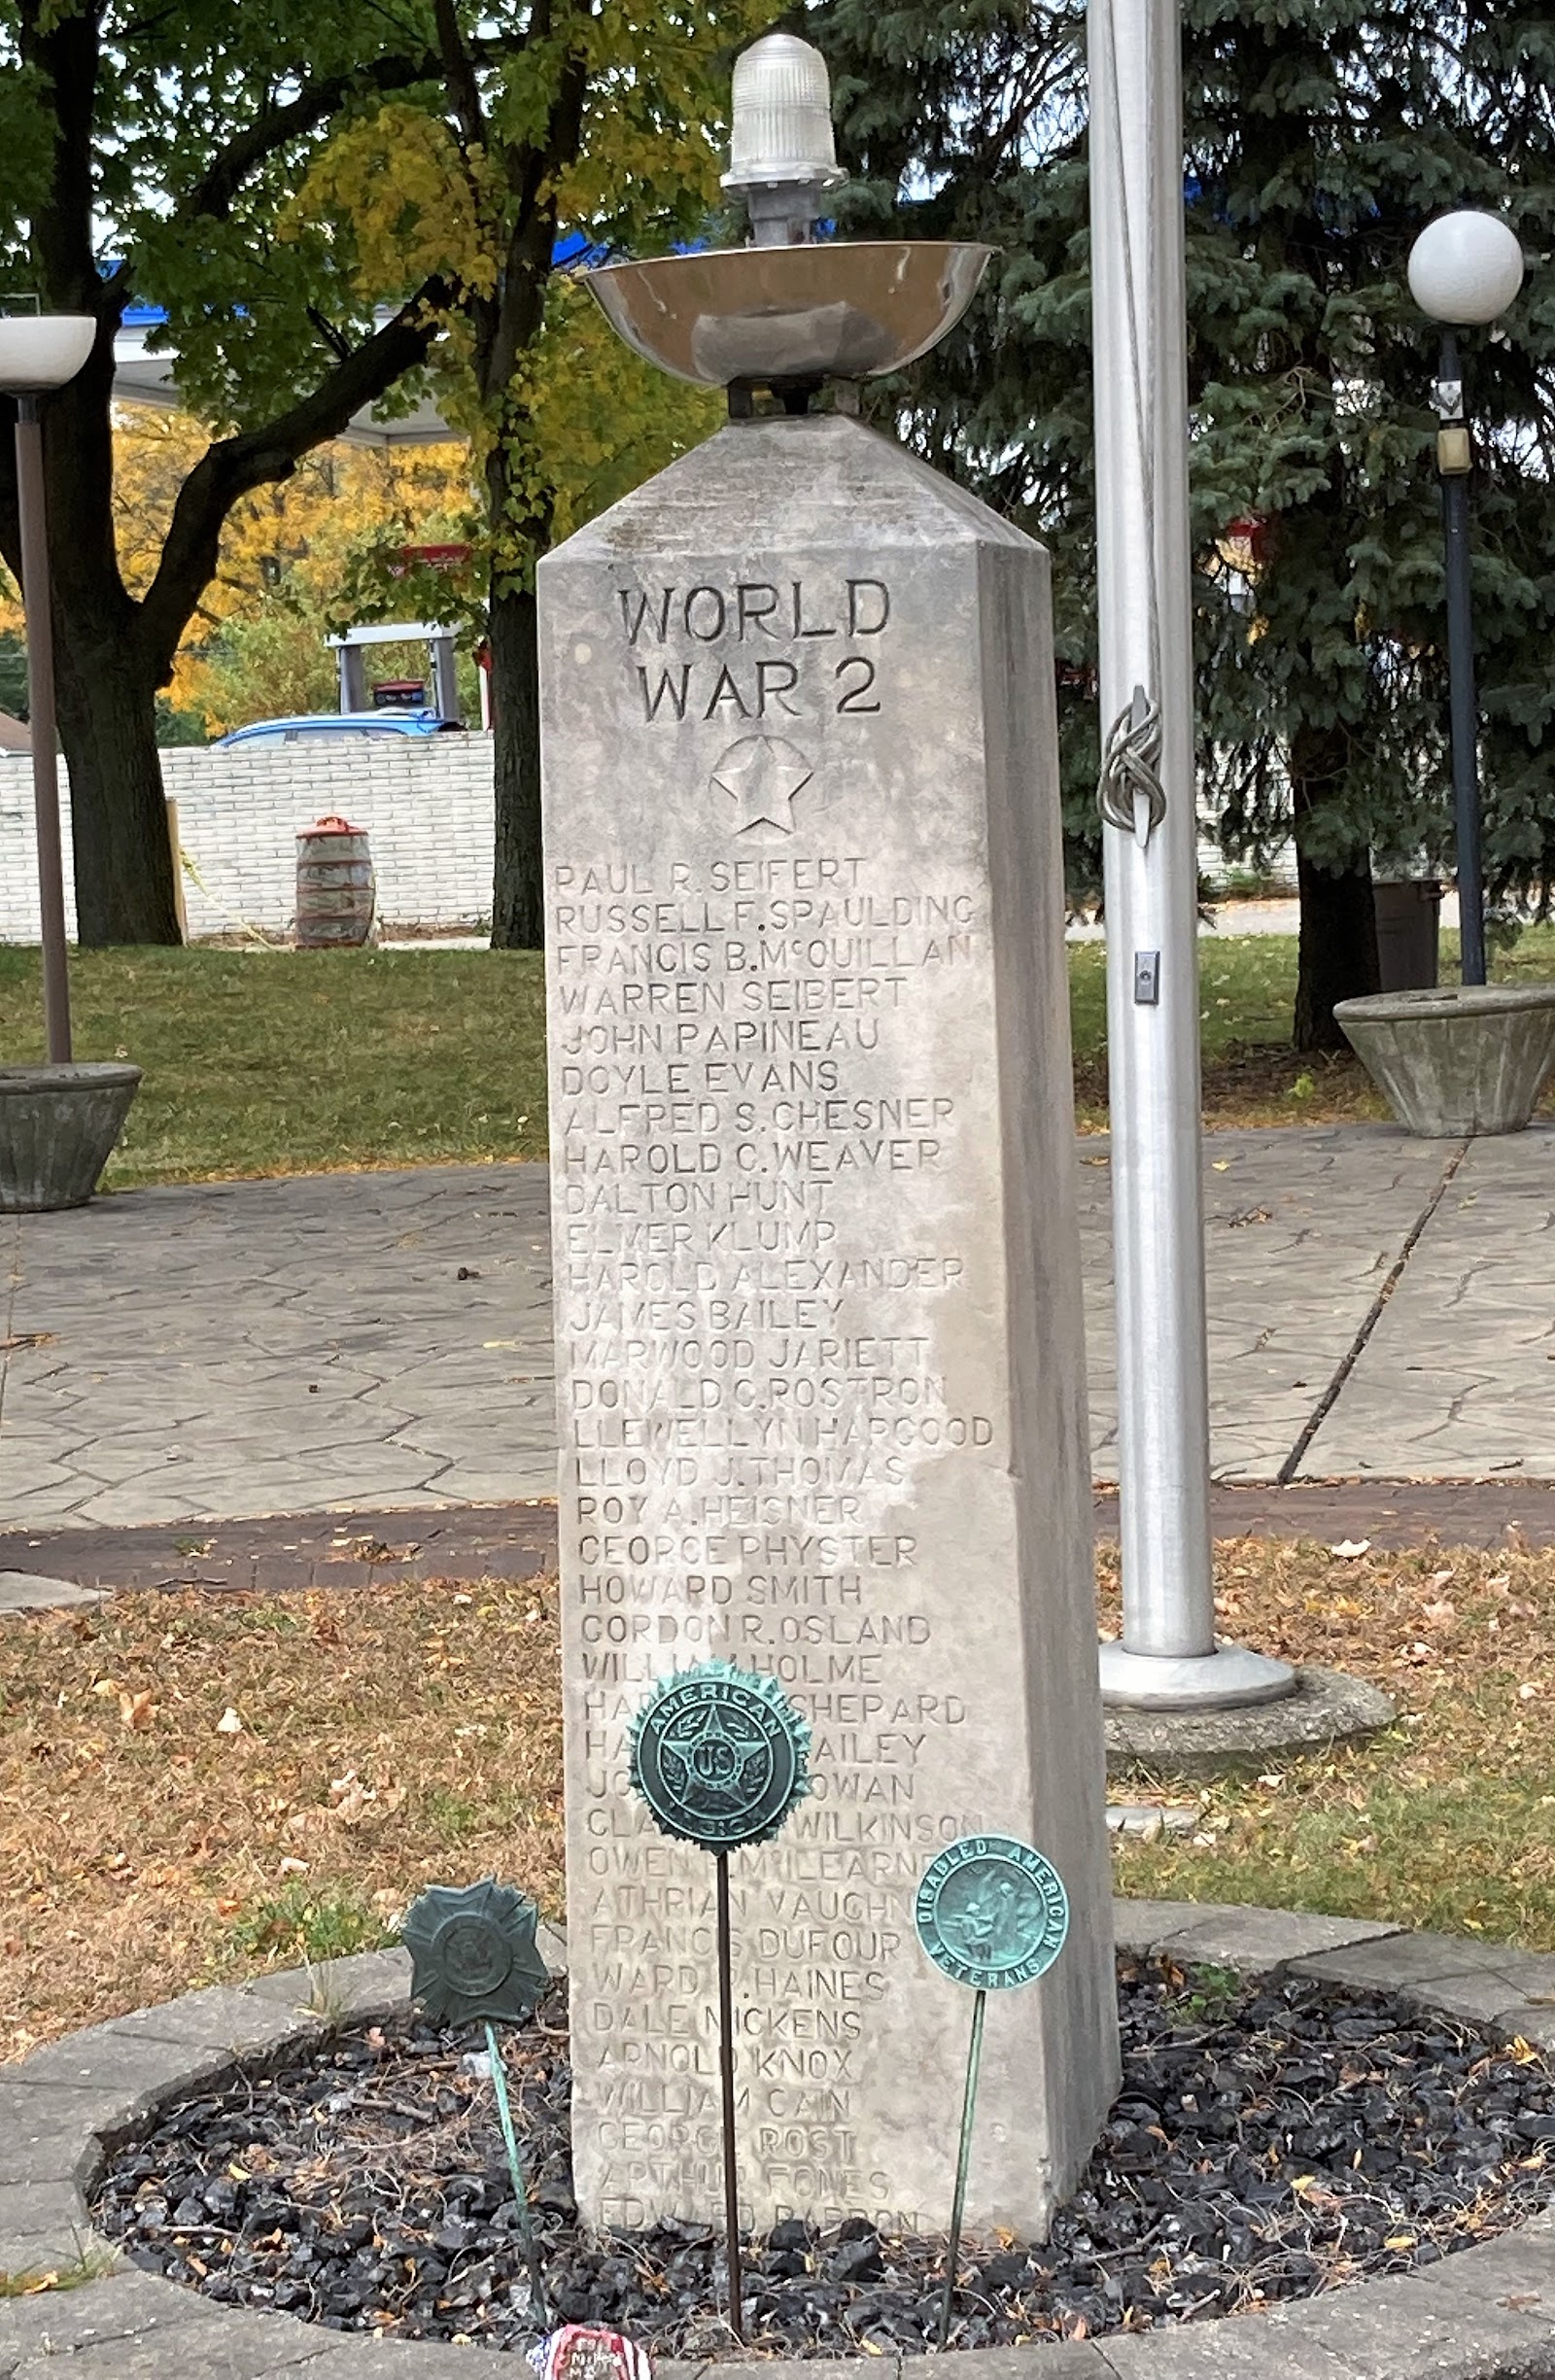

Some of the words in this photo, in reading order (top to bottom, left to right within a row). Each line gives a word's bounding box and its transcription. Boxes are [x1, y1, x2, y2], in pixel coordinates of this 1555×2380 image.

[617, 578, 892, 645] WORLD
[638, 660, 802, 722] WAR
[835, 656, 881, 715] 2
[555, 863, 653, 896] PAUL
[556, 902, 726, 937] RUSSELL
[557, 941, 711, 975] FRANCIS
[560, 982, 725, 1016] WARREN
[742, 976, 908, 1012] SEIBERT
[561, 1023, 663, 1055] JOHN
[676, 1018, 880, 1054] PAPINEAU
[562, 1063, 691, 1095] DOYLE
[705, 1059, 839, 1093] EVANS
[565, 1101, 720, 1136] ALFRED
[564, 1142, 722, 1175] HAROLD
[566, 1183, 715, 1215] DALTON
[729, 1179, 834, 1214] HUNT
[568, 1222, 694, 1255] ELMER
[707, 1219, 837, 1252] KLUMP
[568, 1261, 717, 1293] HAROLD
[731, 1256, 964, 1292] ALEXANDER
[569, 1300, 697, 1332] JAMES
[708, 1298, 845, 1330] BAILEY
[570, 1338, 755, 1370] MARWOOD
[571, 1378, 722, 1411] DONALD
[574, 1417, 804, 1448] LLEWELLYN
[575, 1457, 699, 1487] LLOYD
[577, 1496, 649, 1525] ROY
[578, 1535, 728, 1567] GEORGE
[738, 1535, 918, 1567] PHYSTER
[579, 1574, 734, 1605] HOWARD
[745, 1574, 863, 1605] SMITH
[582, 1614, 731, 1644] GORDON
[749, 1653, 883, 1685] HOLME
[649, 1683, 782, 1739] AMERICAN
[812, 1733, 927, 1765] AILEY
[793, 1811, 984, 1843] WILKINSON
[588, 1845, 691, 1878] OWEN
[766, 1889, 914, 1922] VAUGHN
[917, 1839, 988, 1924] DISABLED
[1007, 1845, 1065, 1950] AMERICAN
[759, 1927, 901, 1961] DUFOUR
[592, 1962, 699, 1995] WARD
[928, 1941, 1042, 1989] VETERANS
[593, 2002, 689, 2034] DALE
[755, 2046, 853, 2081] KNOX
